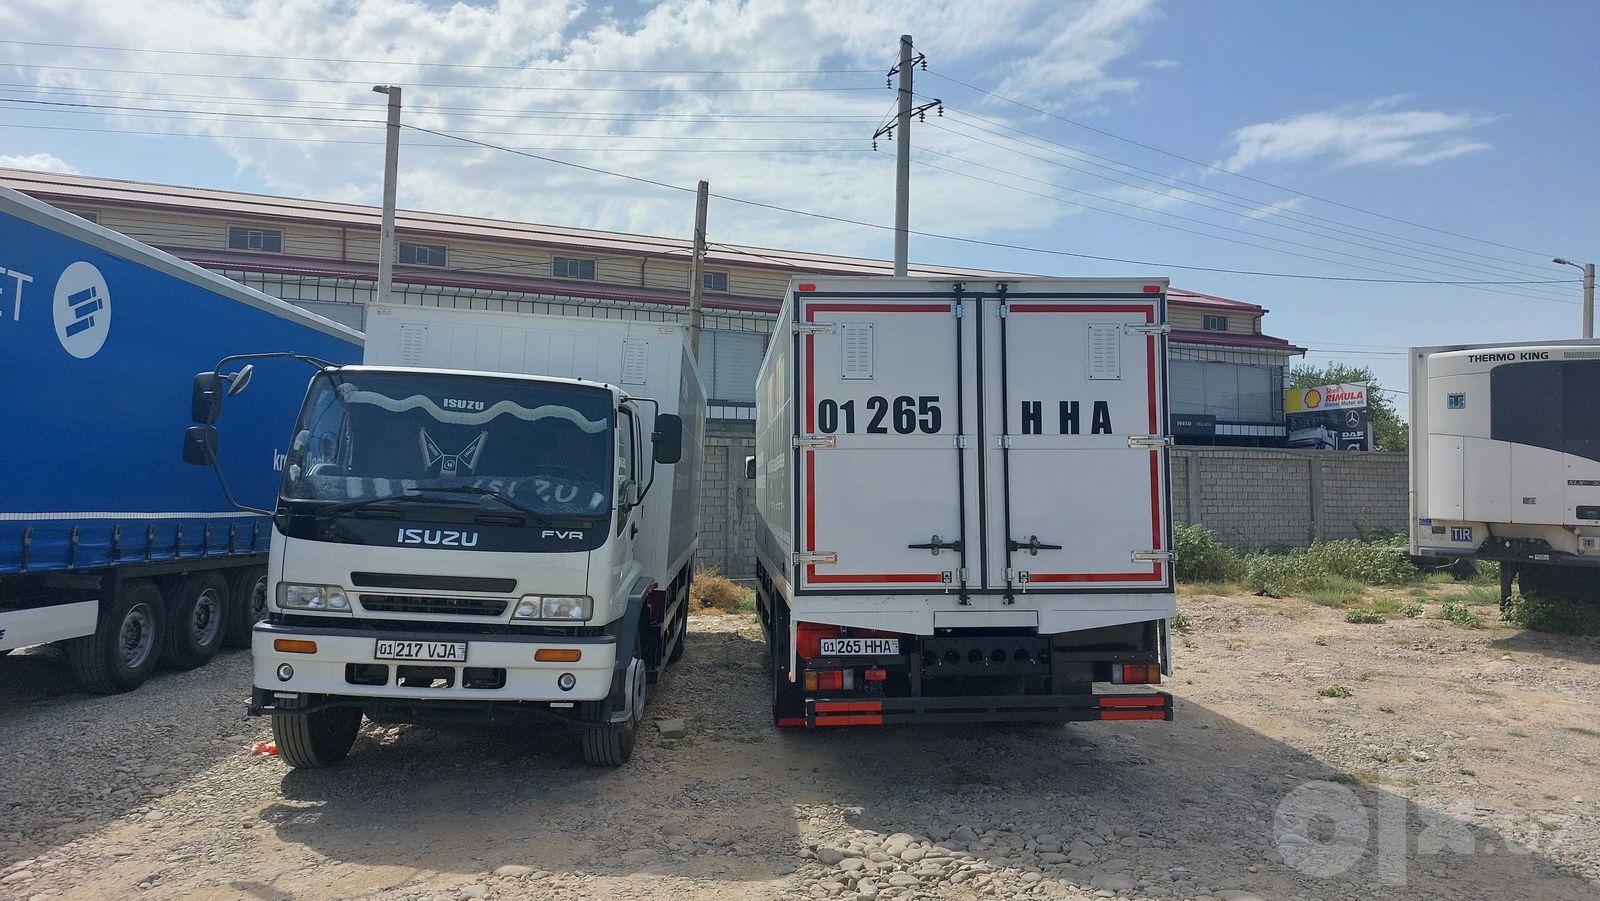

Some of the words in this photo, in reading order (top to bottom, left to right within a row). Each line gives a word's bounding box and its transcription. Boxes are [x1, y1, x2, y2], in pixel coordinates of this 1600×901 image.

[1468, 353, 1515, 363] THERMO
[1520, 351, 1549, 361] KING
[1325, 391, 1363, 402] RIMULA
[443, 398, 485, 410] ISUZU
[818, 398, 855, 434] 01
[866, 395, 942, 434] 265
[397, 528, 478, 547] ISUZU
[541, 530, 584, 541] FVR
[1452, 528, 1471, 540] TIR
[380, 643, 393, 655] 01
[396, 642, 423, 658] 217
[427, 643, 456, 659] VJA
[823, 642, 835, 652] 01
[838, 640, 861, 654] 265
[864, 640, 892, 654] HHA
